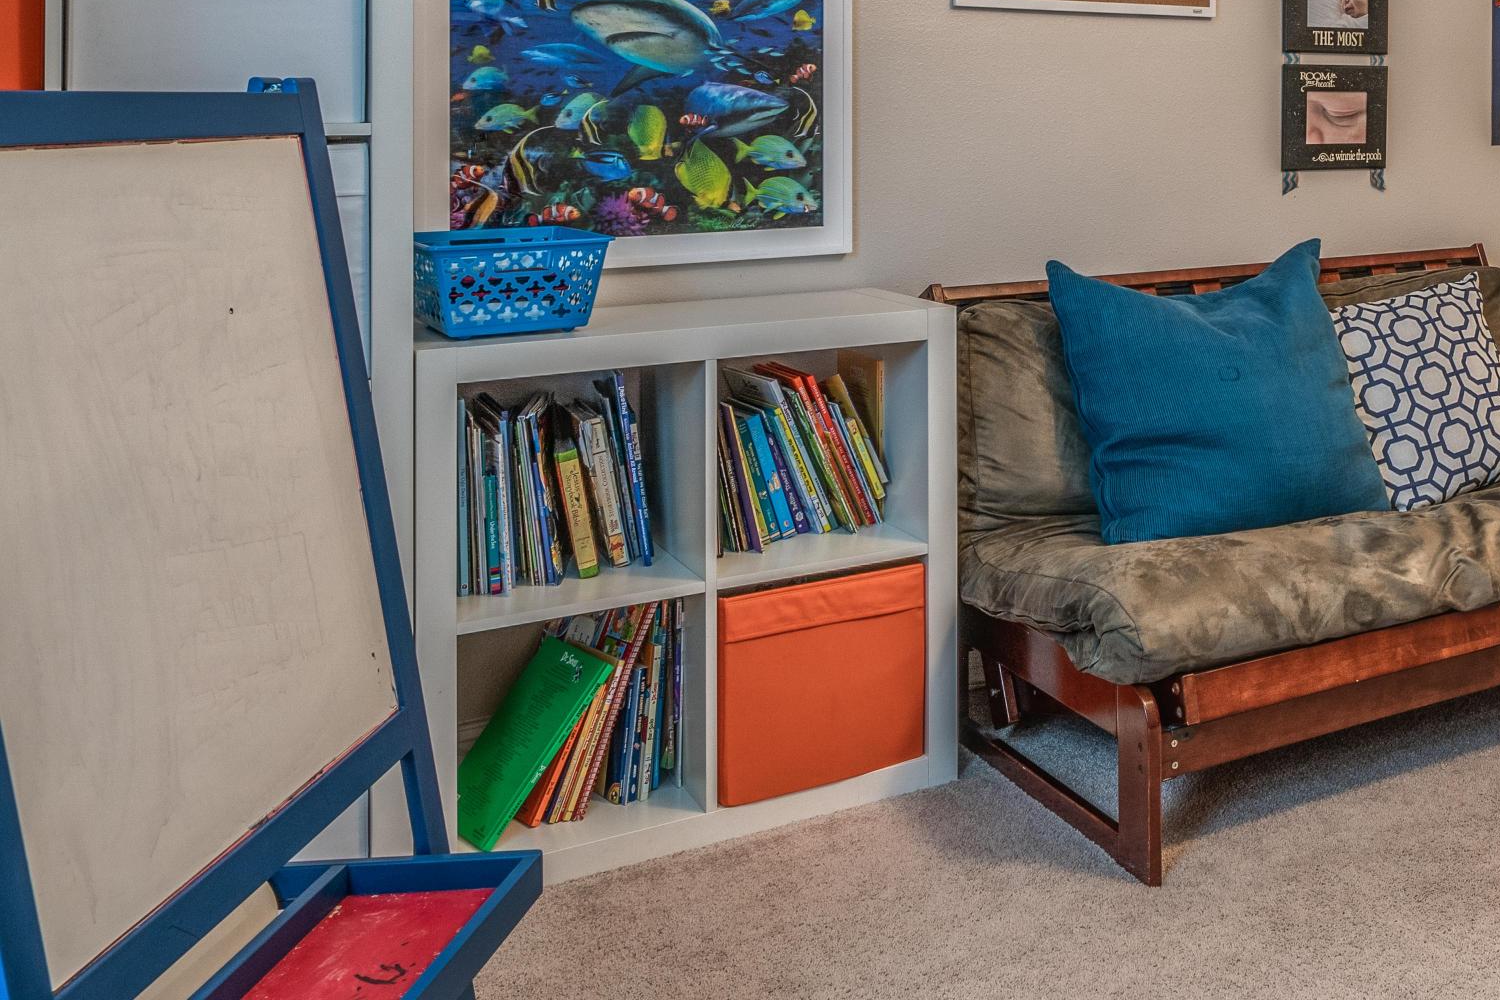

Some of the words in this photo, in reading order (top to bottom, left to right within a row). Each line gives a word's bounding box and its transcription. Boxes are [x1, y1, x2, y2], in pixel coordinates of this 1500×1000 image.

[1312, 30, 1334, 46] THE
[1336, 31, 1365, 47] MOST
[1299, 71, 1331, 80] ROOM
[1335, 149, 1355, 161] winnie
[1355, 148, 1365, 161] the
[1366, 148, 1382, 163] pooh
